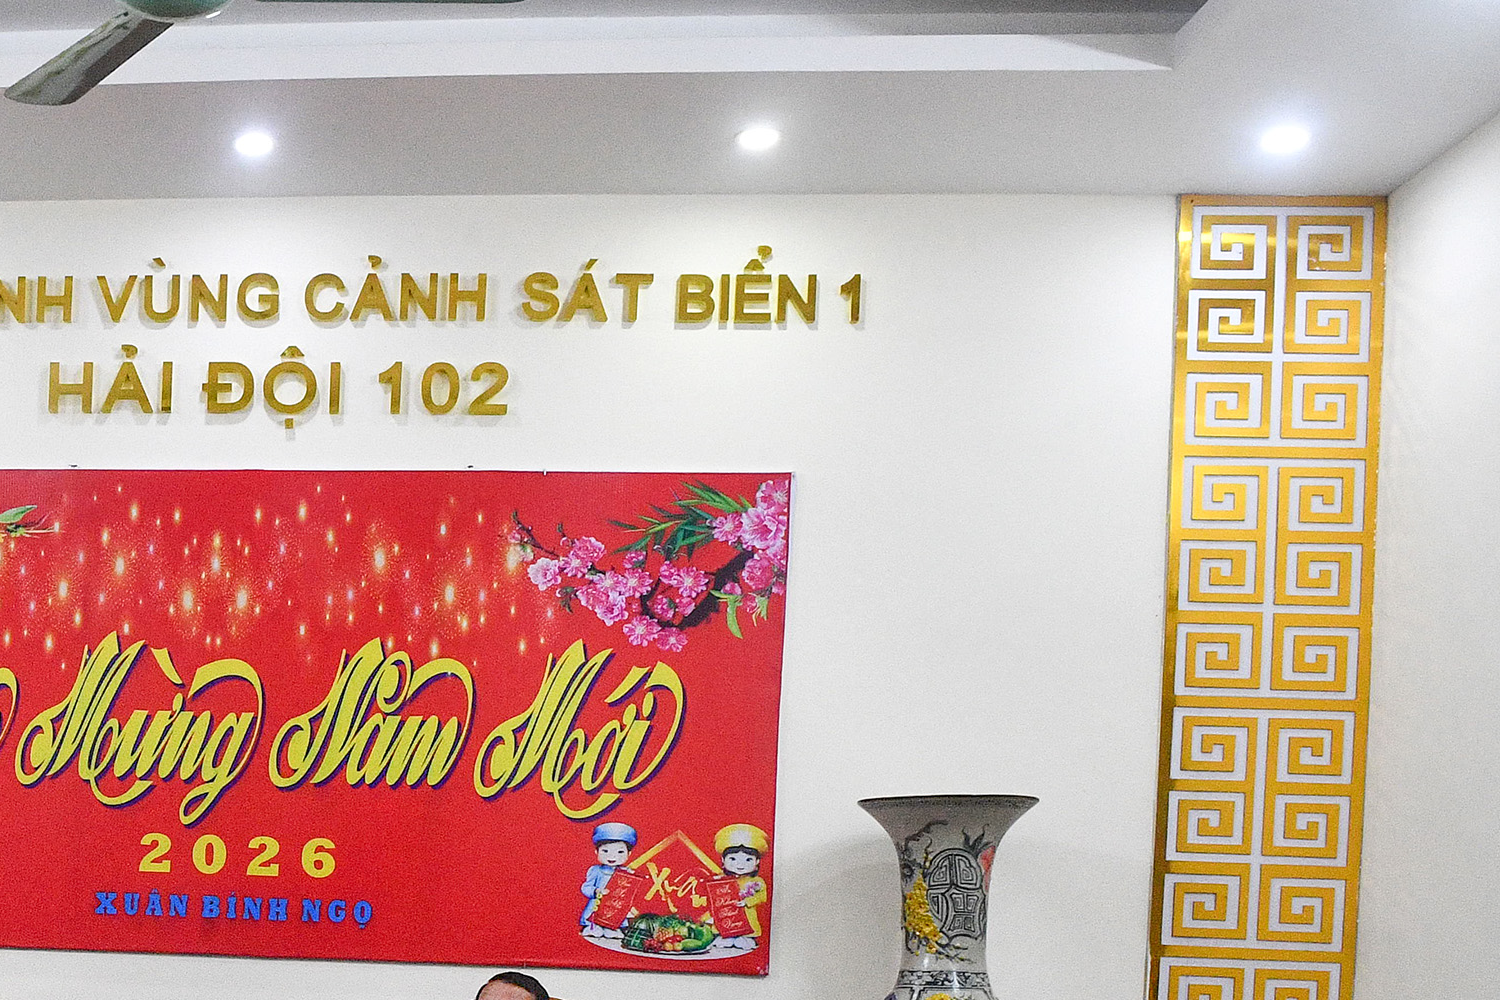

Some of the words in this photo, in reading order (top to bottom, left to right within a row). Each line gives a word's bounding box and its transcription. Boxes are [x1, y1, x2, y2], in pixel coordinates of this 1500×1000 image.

[97, 256, 281, 325] VÙNG
[303, 254, 488, 323] CẢNH
[521, 258, 655, 323] SÁT
[675, 245, 818, 325] BIỂN
[839, 273, 863, 325] 1
[47, 344, 174, 415] HẢI
[201, 345, 342, 430] ĐỘI
[377, 361, 510, 416] 102
[15, 631, 265, 827] Mừng
[269, 637, 476, 792] Năm
[473, 638, 686, 822] Mới
[138, 832, 337, 879] 2026
[94, 888, 189, 918] XUÂN
[301, 898, 373, 930] NGỌ
